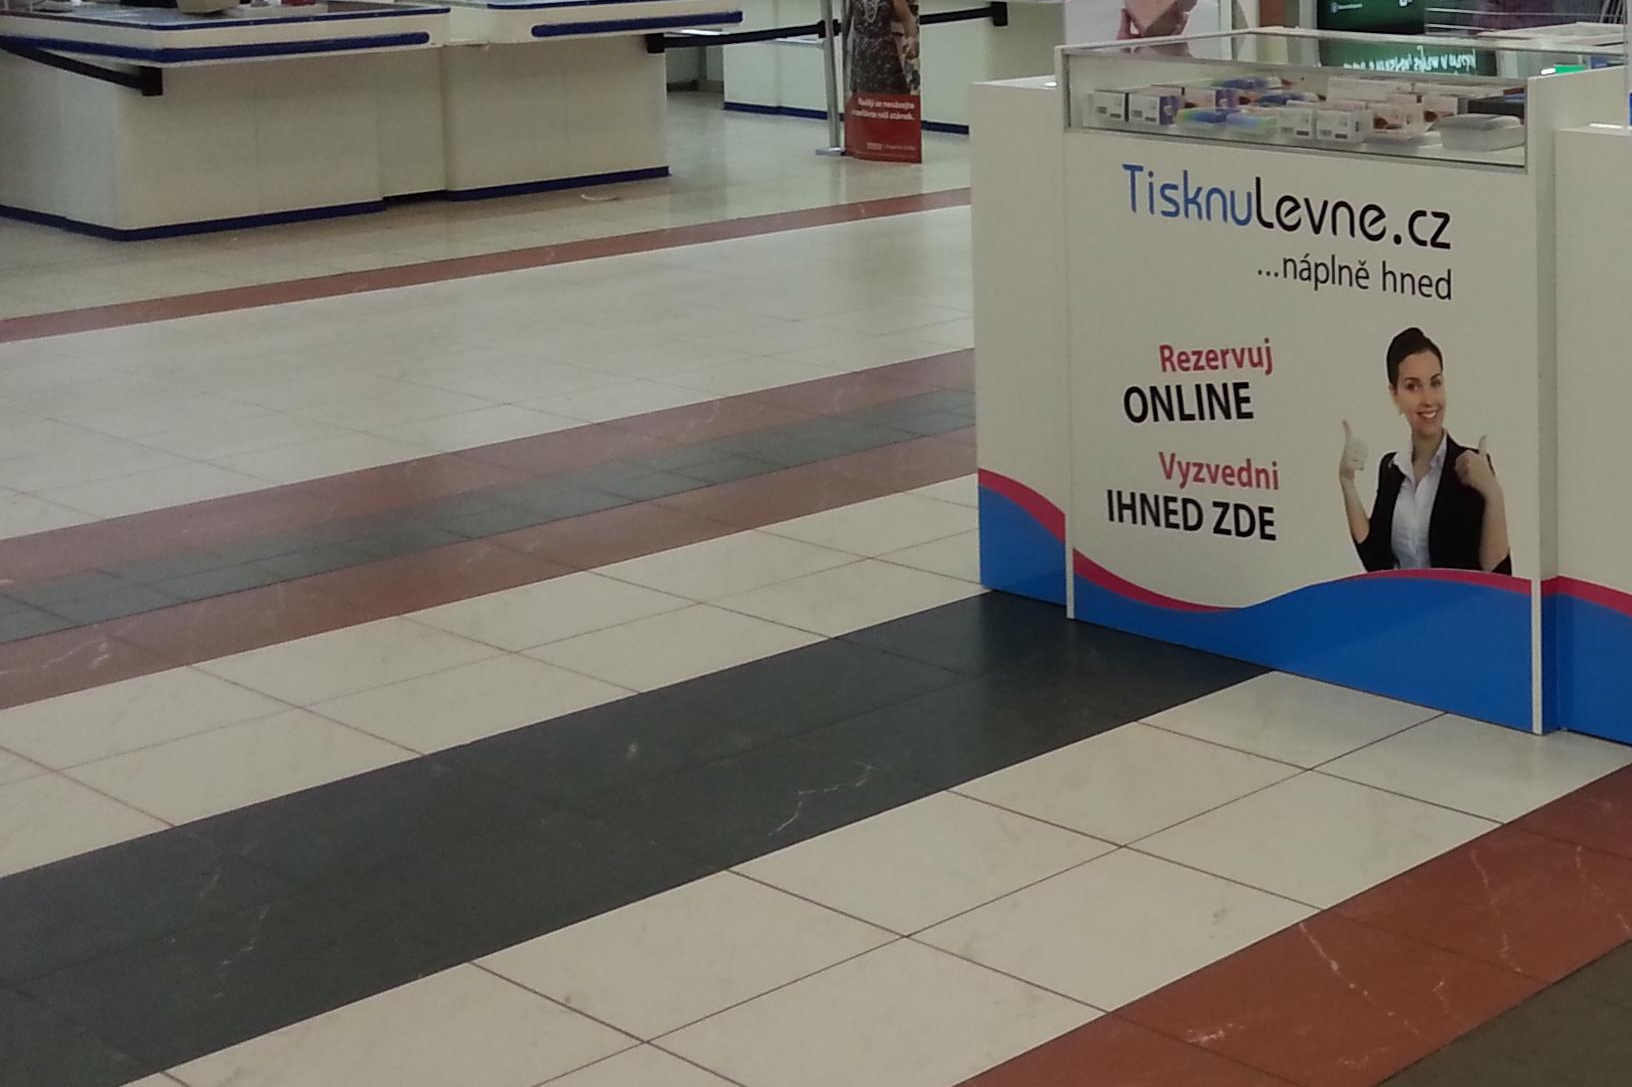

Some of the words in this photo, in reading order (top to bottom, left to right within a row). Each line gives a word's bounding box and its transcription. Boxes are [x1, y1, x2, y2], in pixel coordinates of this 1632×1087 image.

[1382, 259, 1452, 301] hned
[1159, 337, 1274, 376] Rezervuj
[1123, 381, 1254, 424] ONLINE
[1158, 451, 1279, 490] Vyzvedni
[1106, 489, 1204, 532] IHNED
[1212, 500, 1277, 541] ZDE
